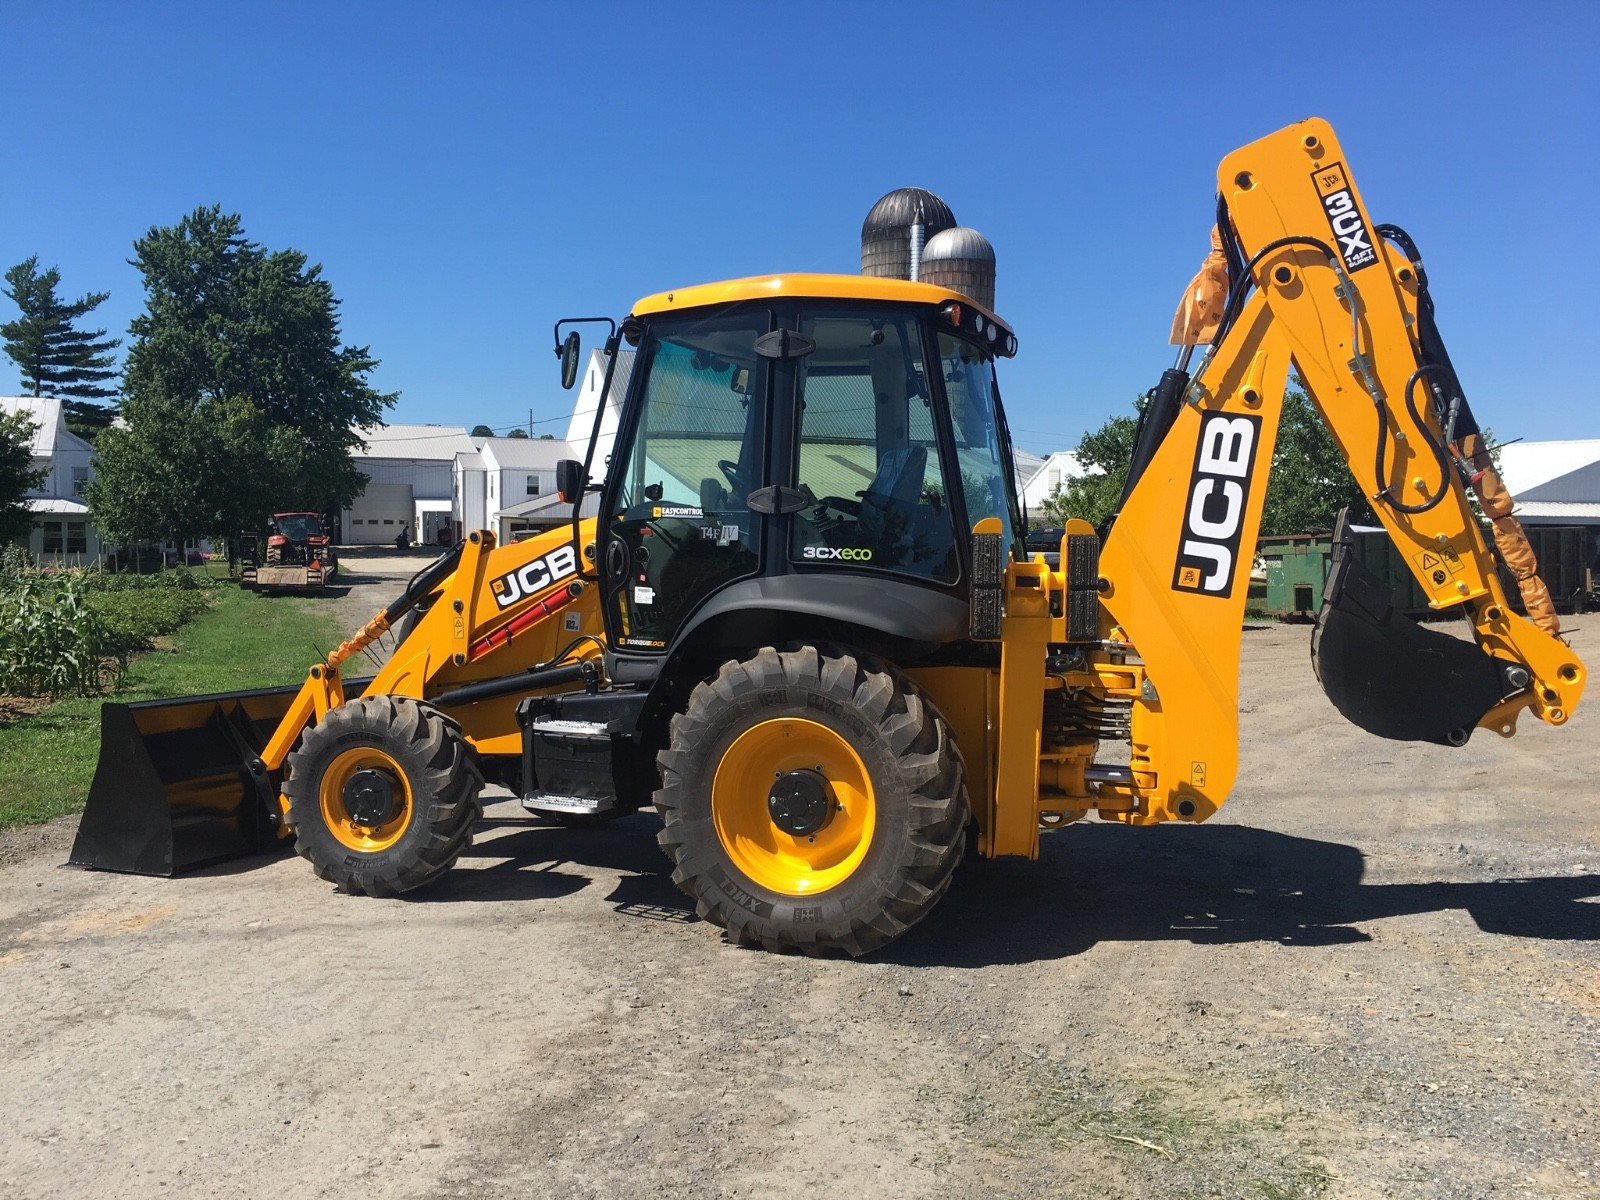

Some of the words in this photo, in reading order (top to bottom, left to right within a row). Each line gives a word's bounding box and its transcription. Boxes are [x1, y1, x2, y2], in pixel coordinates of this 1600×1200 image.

[1322, 174, 1339, 188] JCB
[1325, 191, 1372, 258] 3CX
[1345, 248, 1374, 263] 14FT
[1348, 254, 1375, 269] SUPER
[1184, 416, 1255, 592] JCB
[661, 507, 704, 517] EASYCONTROL
[803, 546, 873, 561] 3CXeco
[497, 545, 577, 606] JCB
[718, 876, 763, 914] XMCL
